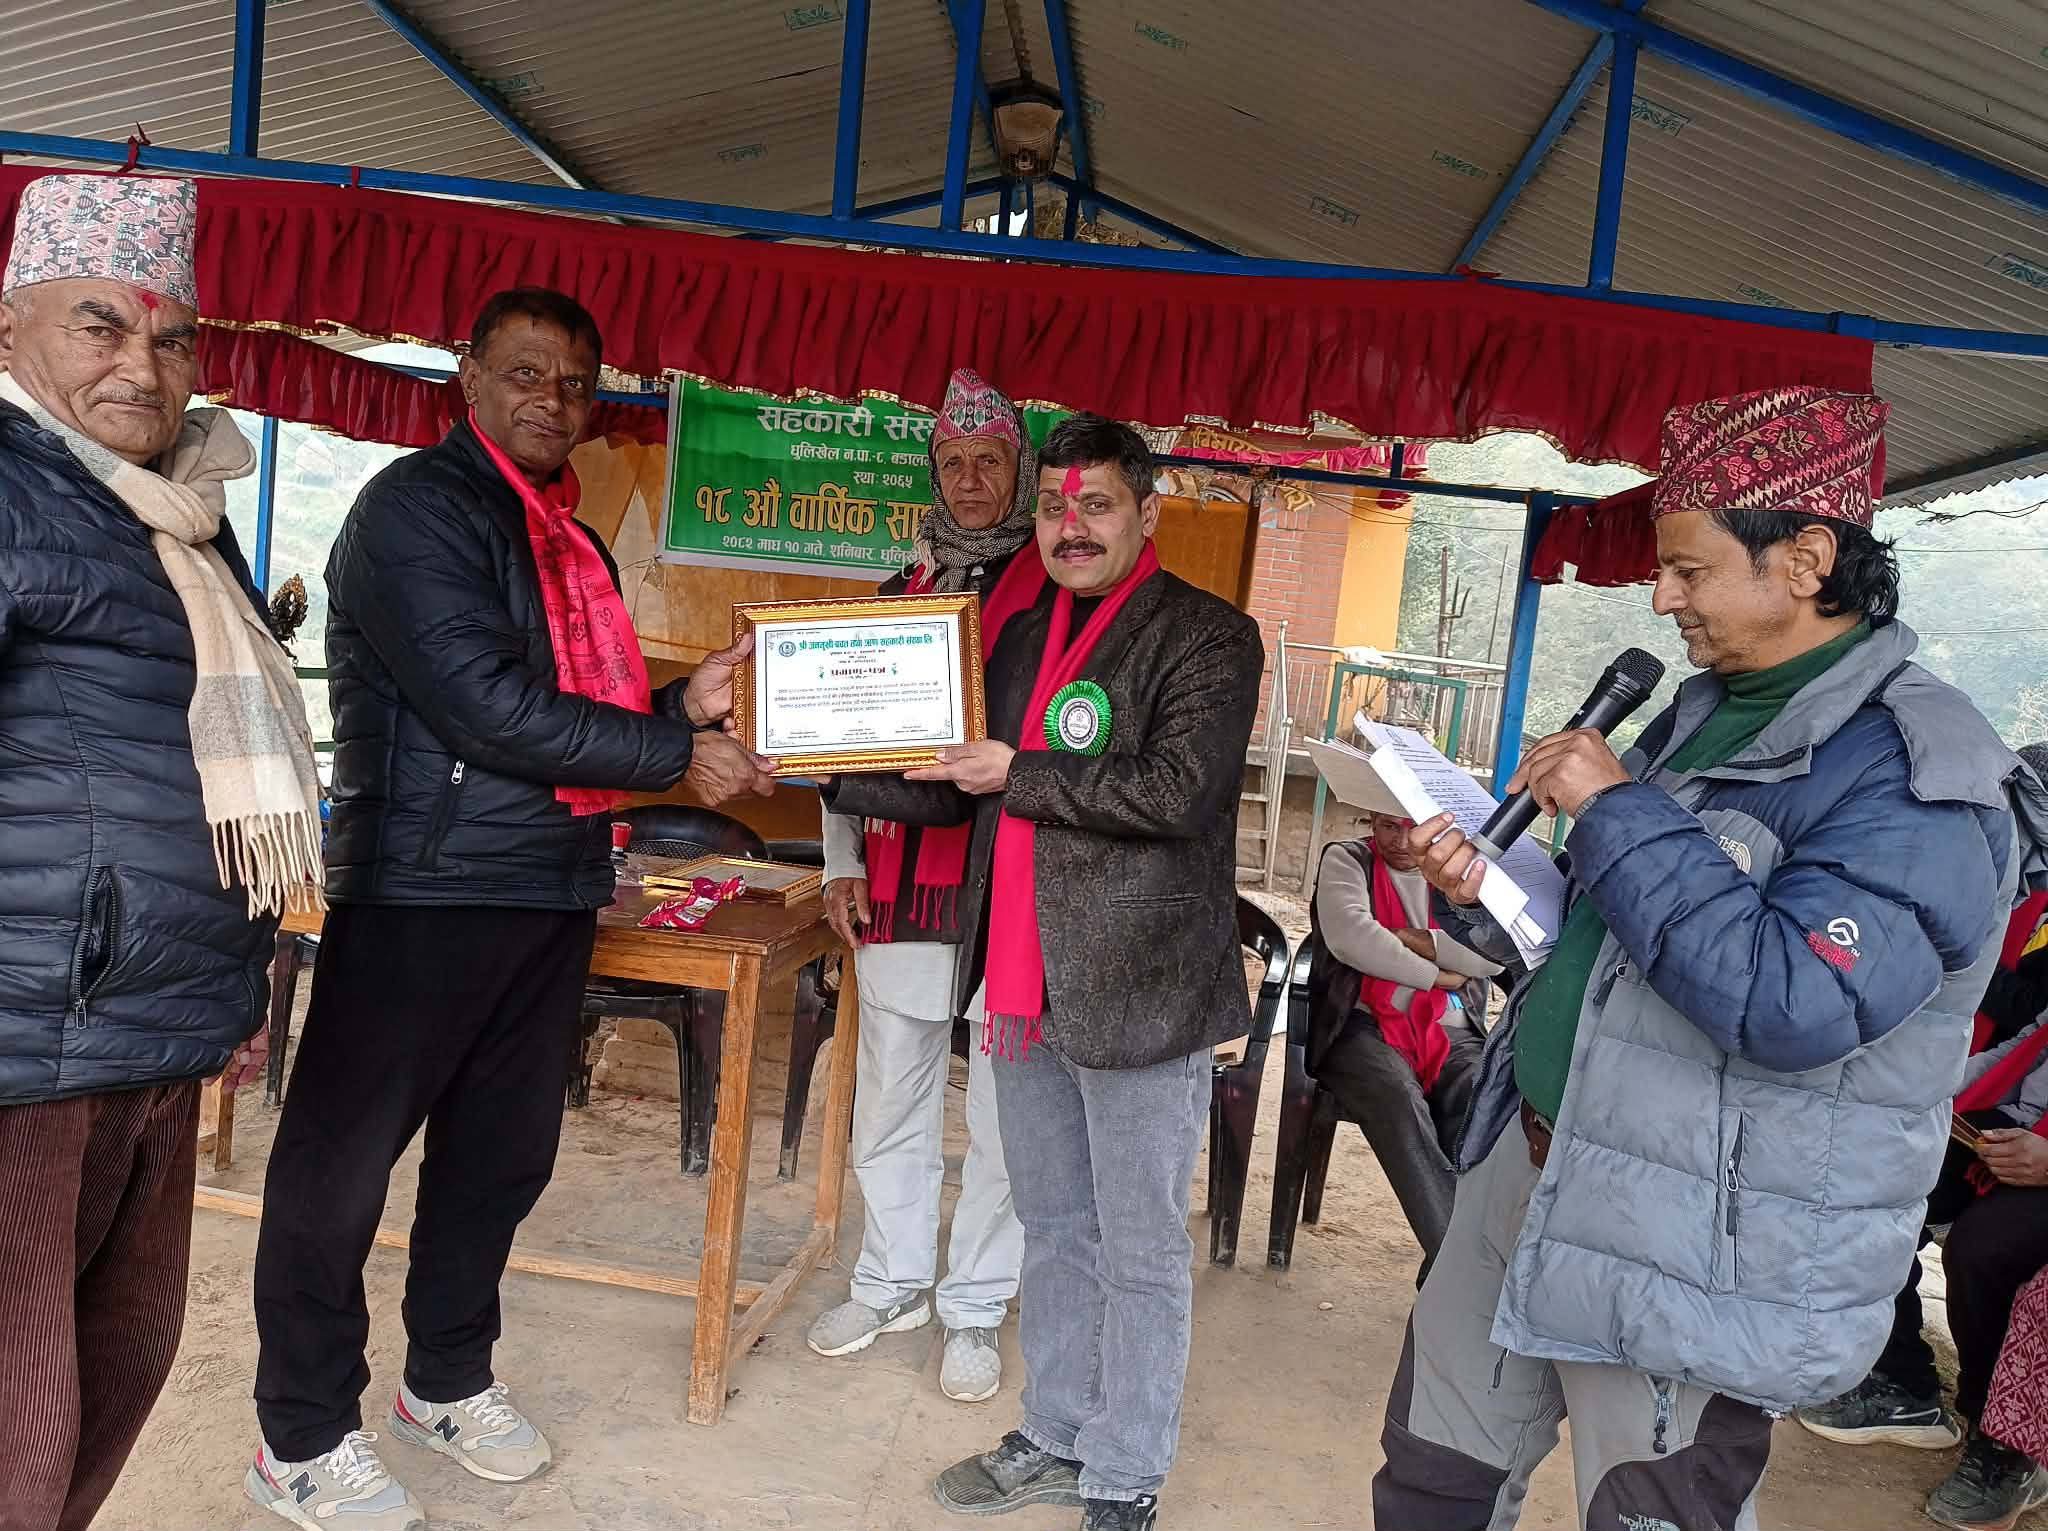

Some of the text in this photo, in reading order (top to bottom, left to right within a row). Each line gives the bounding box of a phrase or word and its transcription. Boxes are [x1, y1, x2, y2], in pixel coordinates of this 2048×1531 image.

[757, 405, 937, 442] सहकारी संस्
[695, 485, 733, 524] १८
[789, 481, 879, 536] वार्षिक
[722, 535, 753, 549] २०८२
[757, 538, 781, 552] माघ
[784, 540, 800, 553] १०
